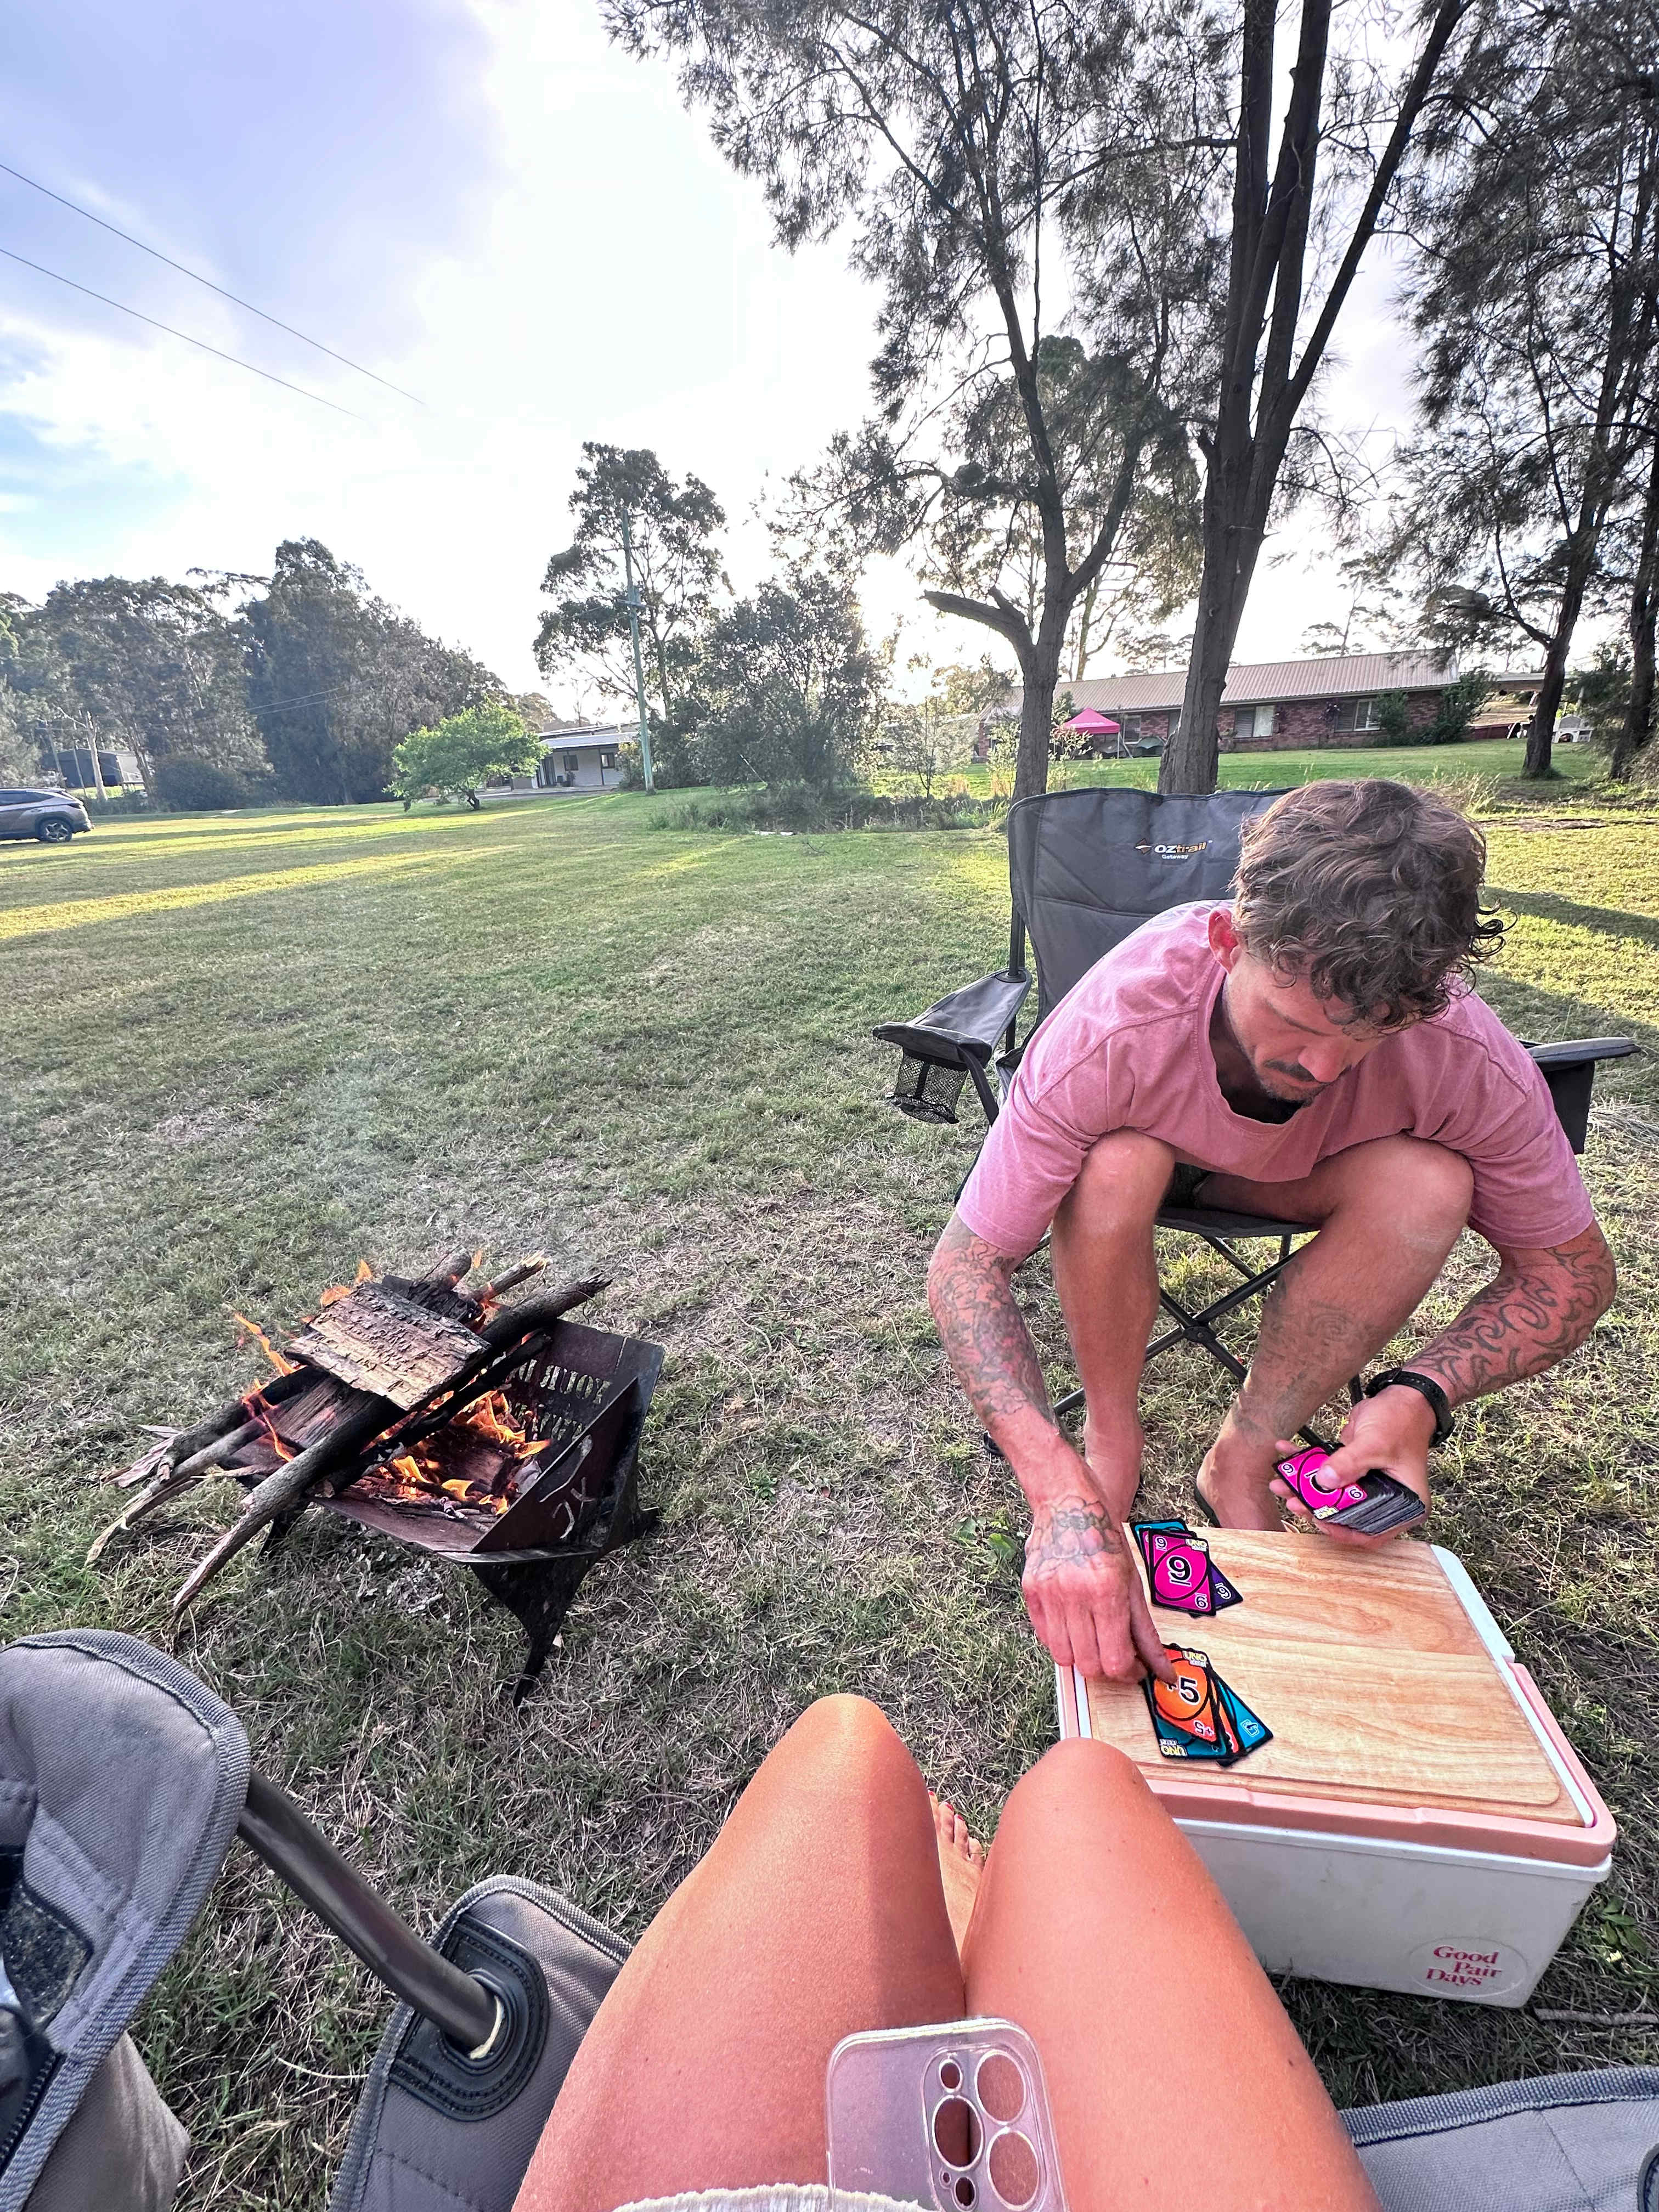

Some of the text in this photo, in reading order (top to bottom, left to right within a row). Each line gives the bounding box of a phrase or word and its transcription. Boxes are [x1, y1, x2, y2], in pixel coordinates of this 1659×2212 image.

[1155, 1537, 1167, 1551] 9
[1167, 1555, 1192, 1585] 9
[1182, 1651, 1207, 1662] UNO
[1433, 1946, 1499, 1965] Good
[1426, 1968, 1483, 1987] Days
[1454, 1961, 1503, 1978] Pair
